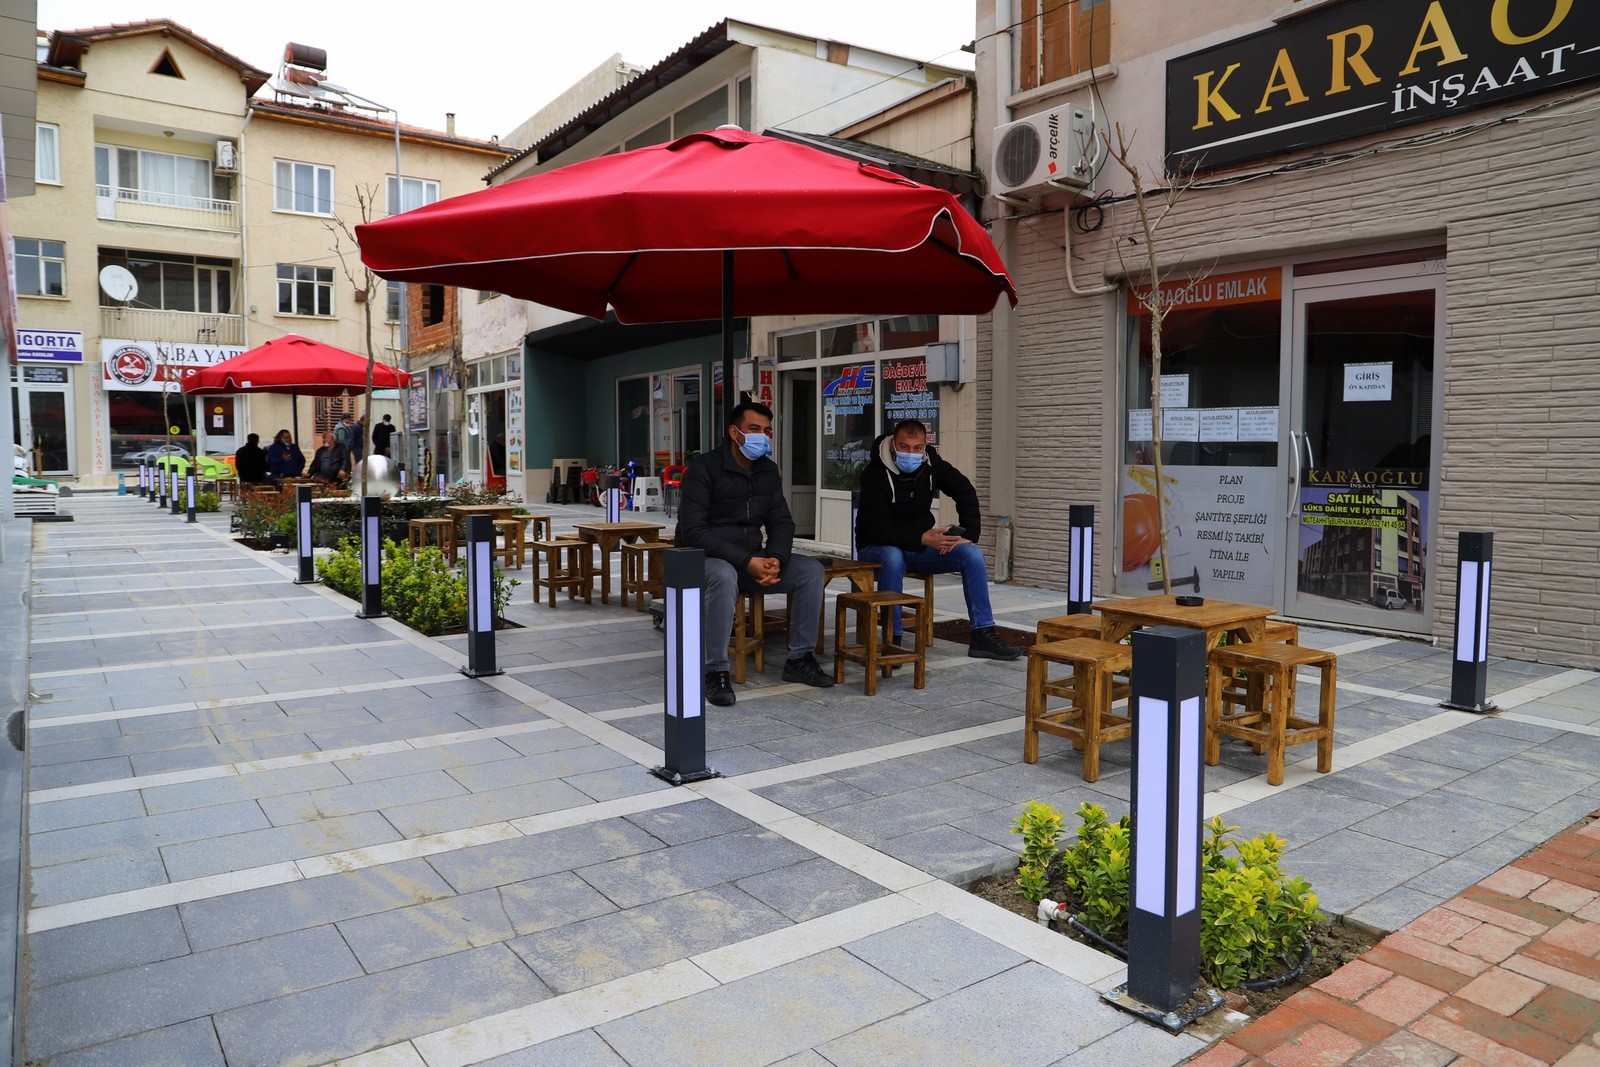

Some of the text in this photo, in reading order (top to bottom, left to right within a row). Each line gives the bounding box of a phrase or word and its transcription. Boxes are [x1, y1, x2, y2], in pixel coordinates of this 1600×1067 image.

[1391, 43, 1575, 114] İNŞAAT
[1049, 113, 1061, 160] arçelik
[1217, 276, 1268, 300] EMLAK
[204, 349, 246, 363] YAP
[1355, 371, 1380, 382] GİRİŞ
[896, 379, 928, 393] EMLAK
[887, 410, 893, 419] 0
[1219, 475, 1243, 485] PLAN
[1308, 468, 1423, 485] KARAOĞLU
[1216, 494, 1245, 504] PROJE
[1328, 493, 1376, 504] SATILIK
[1303, 503, 1323, 512] LÜKS
[1325, 504, 1348, 513] DAİRE
[1362, 507, 1405, 516] İŞYERLERİ
[1195, 511, 1267, 525] ŞANTİYE ŞEFLİĞİ
[1196, 530, 1265, 544] RESMİ İŞ TAKİBİ
[1209, 548, 1250, 562] İTİNA İLE
[1212, 568, 1245, 581] YAPILIR
